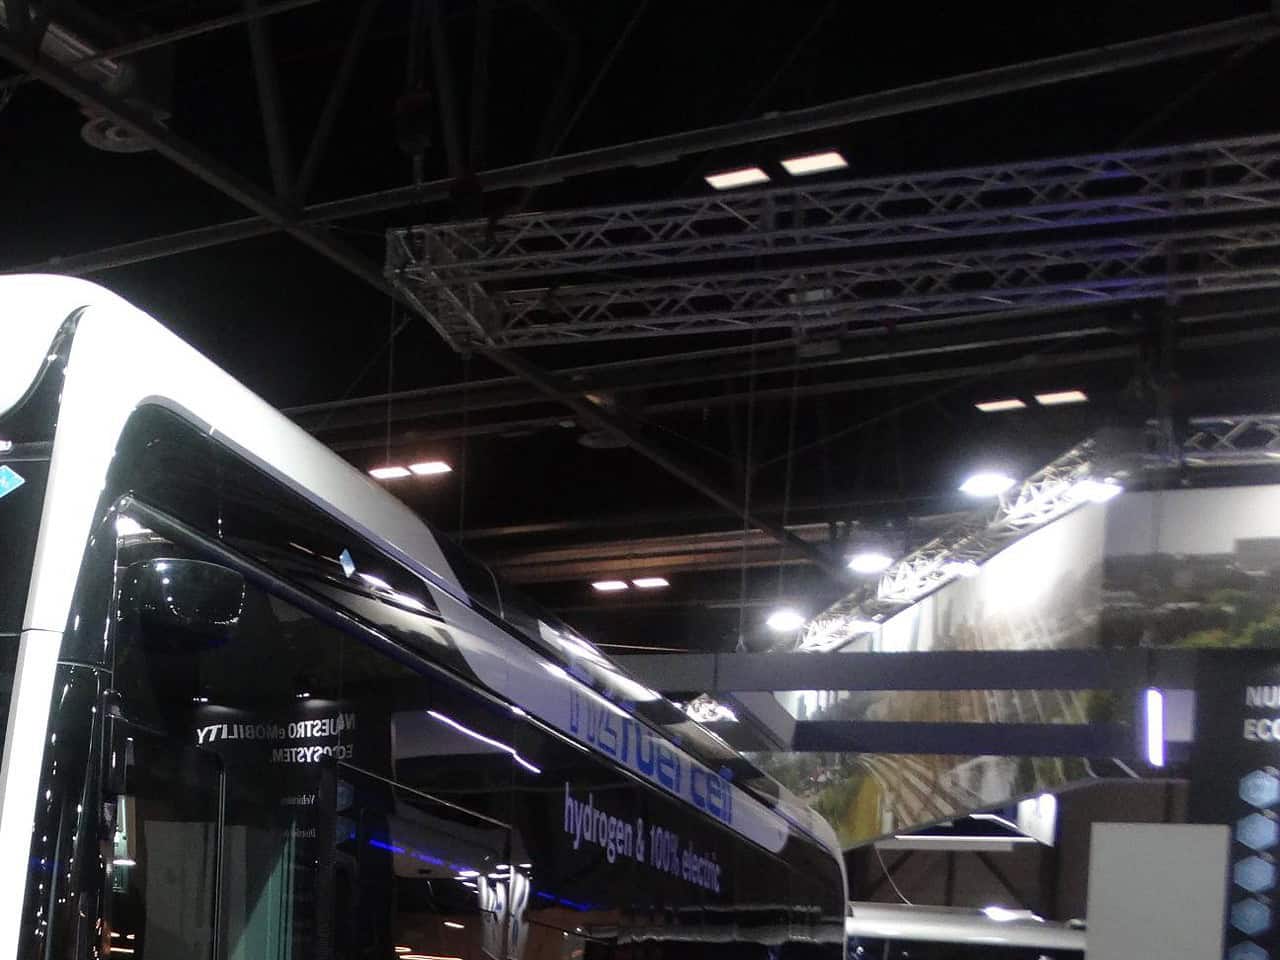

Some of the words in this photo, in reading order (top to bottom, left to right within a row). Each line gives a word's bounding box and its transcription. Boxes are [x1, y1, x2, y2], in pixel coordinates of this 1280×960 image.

[1245, 685, 1280, 708] NU
[564, 781, 633, 864] hydrogen
[634, 817, 646, 862] &
